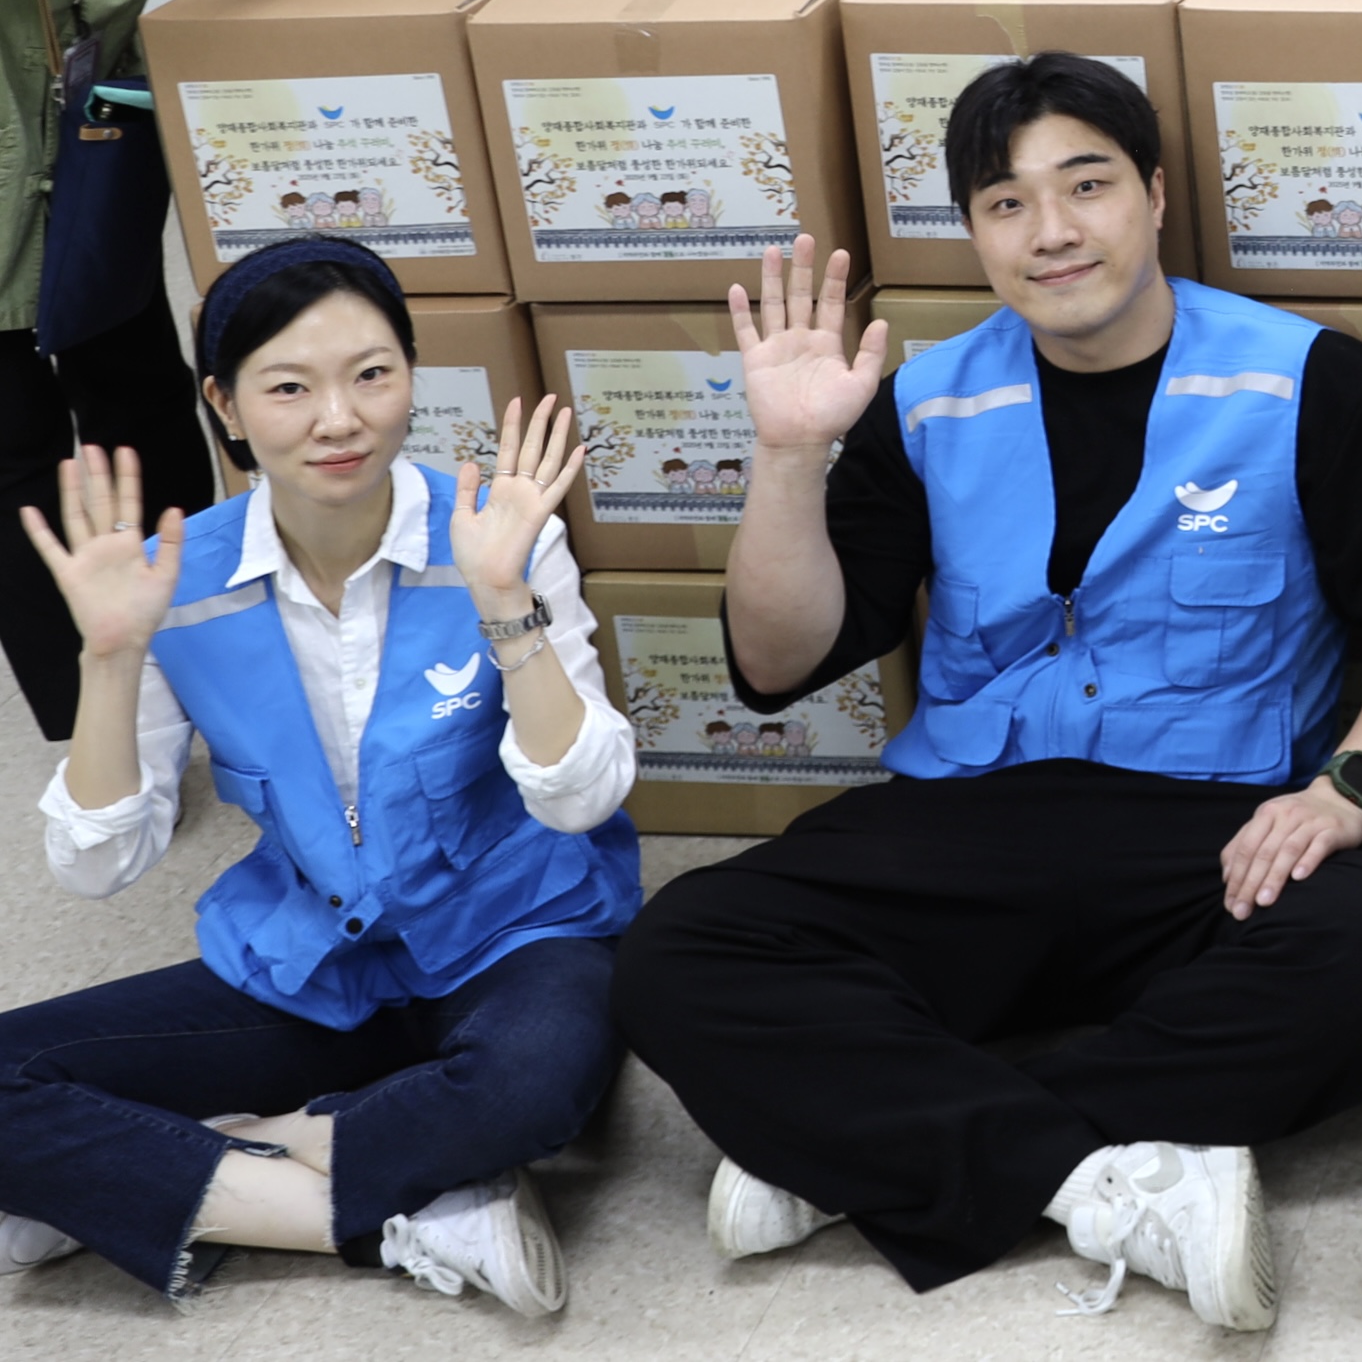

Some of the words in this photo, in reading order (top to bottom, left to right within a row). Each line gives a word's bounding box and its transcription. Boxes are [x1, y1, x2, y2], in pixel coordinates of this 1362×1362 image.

[652, 120, 676, 129] SPC
[719, 117, 753, 130] 준비한
[1247, 125, 1357, 138] 양재종합사회복지관과
[574, 139, 608, 152] 한가위
[1280, 145, 1314, 158] 한가위
[1177, 514, 1229, 533] SPC
[429, 691, 482, 720] SPC
